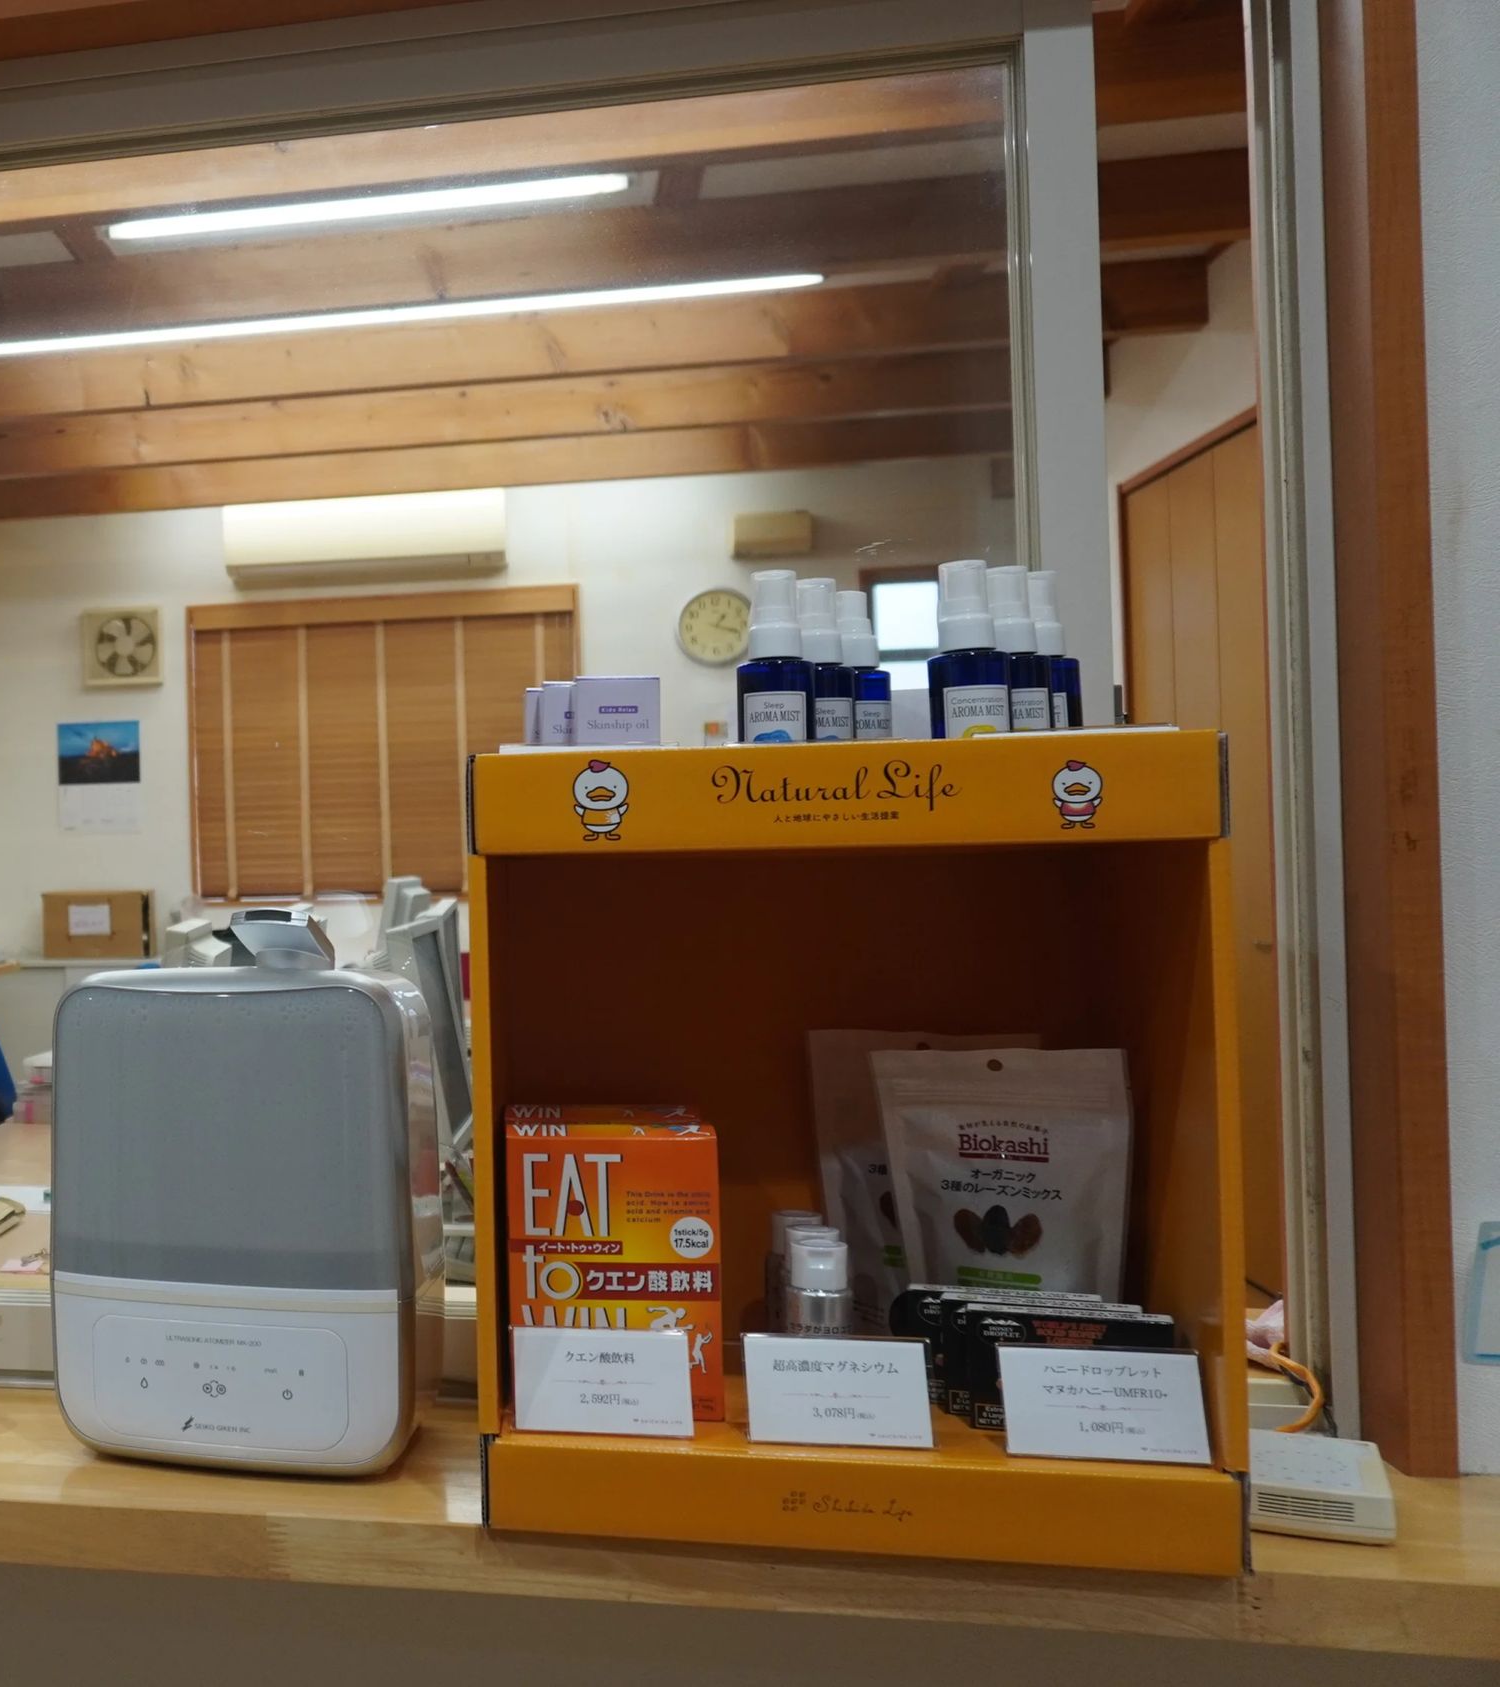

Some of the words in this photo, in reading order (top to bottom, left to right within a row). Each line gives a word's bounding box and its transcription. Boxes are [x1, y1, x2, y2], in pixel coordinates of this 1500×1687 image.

[763, 702, 785, 710] Sleep
[952, 705, 985, 718] AROMA
[986, 704, 1004, 717] MIST
[750, 711, 780, 723] AROMA
[780, 710, 801, 722] MIST
[1025, 707, 1044, 719] MIST
[587, 720, 632, 732] Skinship
[635, 719, 650, 729] oil
[832, 716, 849, 727] MIST
[711, 765, 871, 804] Natural
[877, 760, 964, 811] Life
[773, 811, 900, 824] 人と地球にやさしい生活提案
[512, 1125, 568, 1137] WIN
[958, 1134, 1050, 1155] Biokashi
[971, 1168, 1036, 1183] オーガニック
[522, 1153, 623, 1238] EAT
[941, 1180, 1062, 1200] 3種のレーズンミックス
[674, 1228, 709, 1238] 1stick/5g
[538, 1241, 621, 1254] イート・トゥ・ウィン
[674, 1238, 709, 1248] 17.5kcal
[522, 1245, 583, 1300] to
[586, 1270, 713, 1293] クエン酸飲料
[565, 1351, 635, 1365] クエン酸飲料
[772, 1359, 899, 1375] 超高濃度マグネシウム
